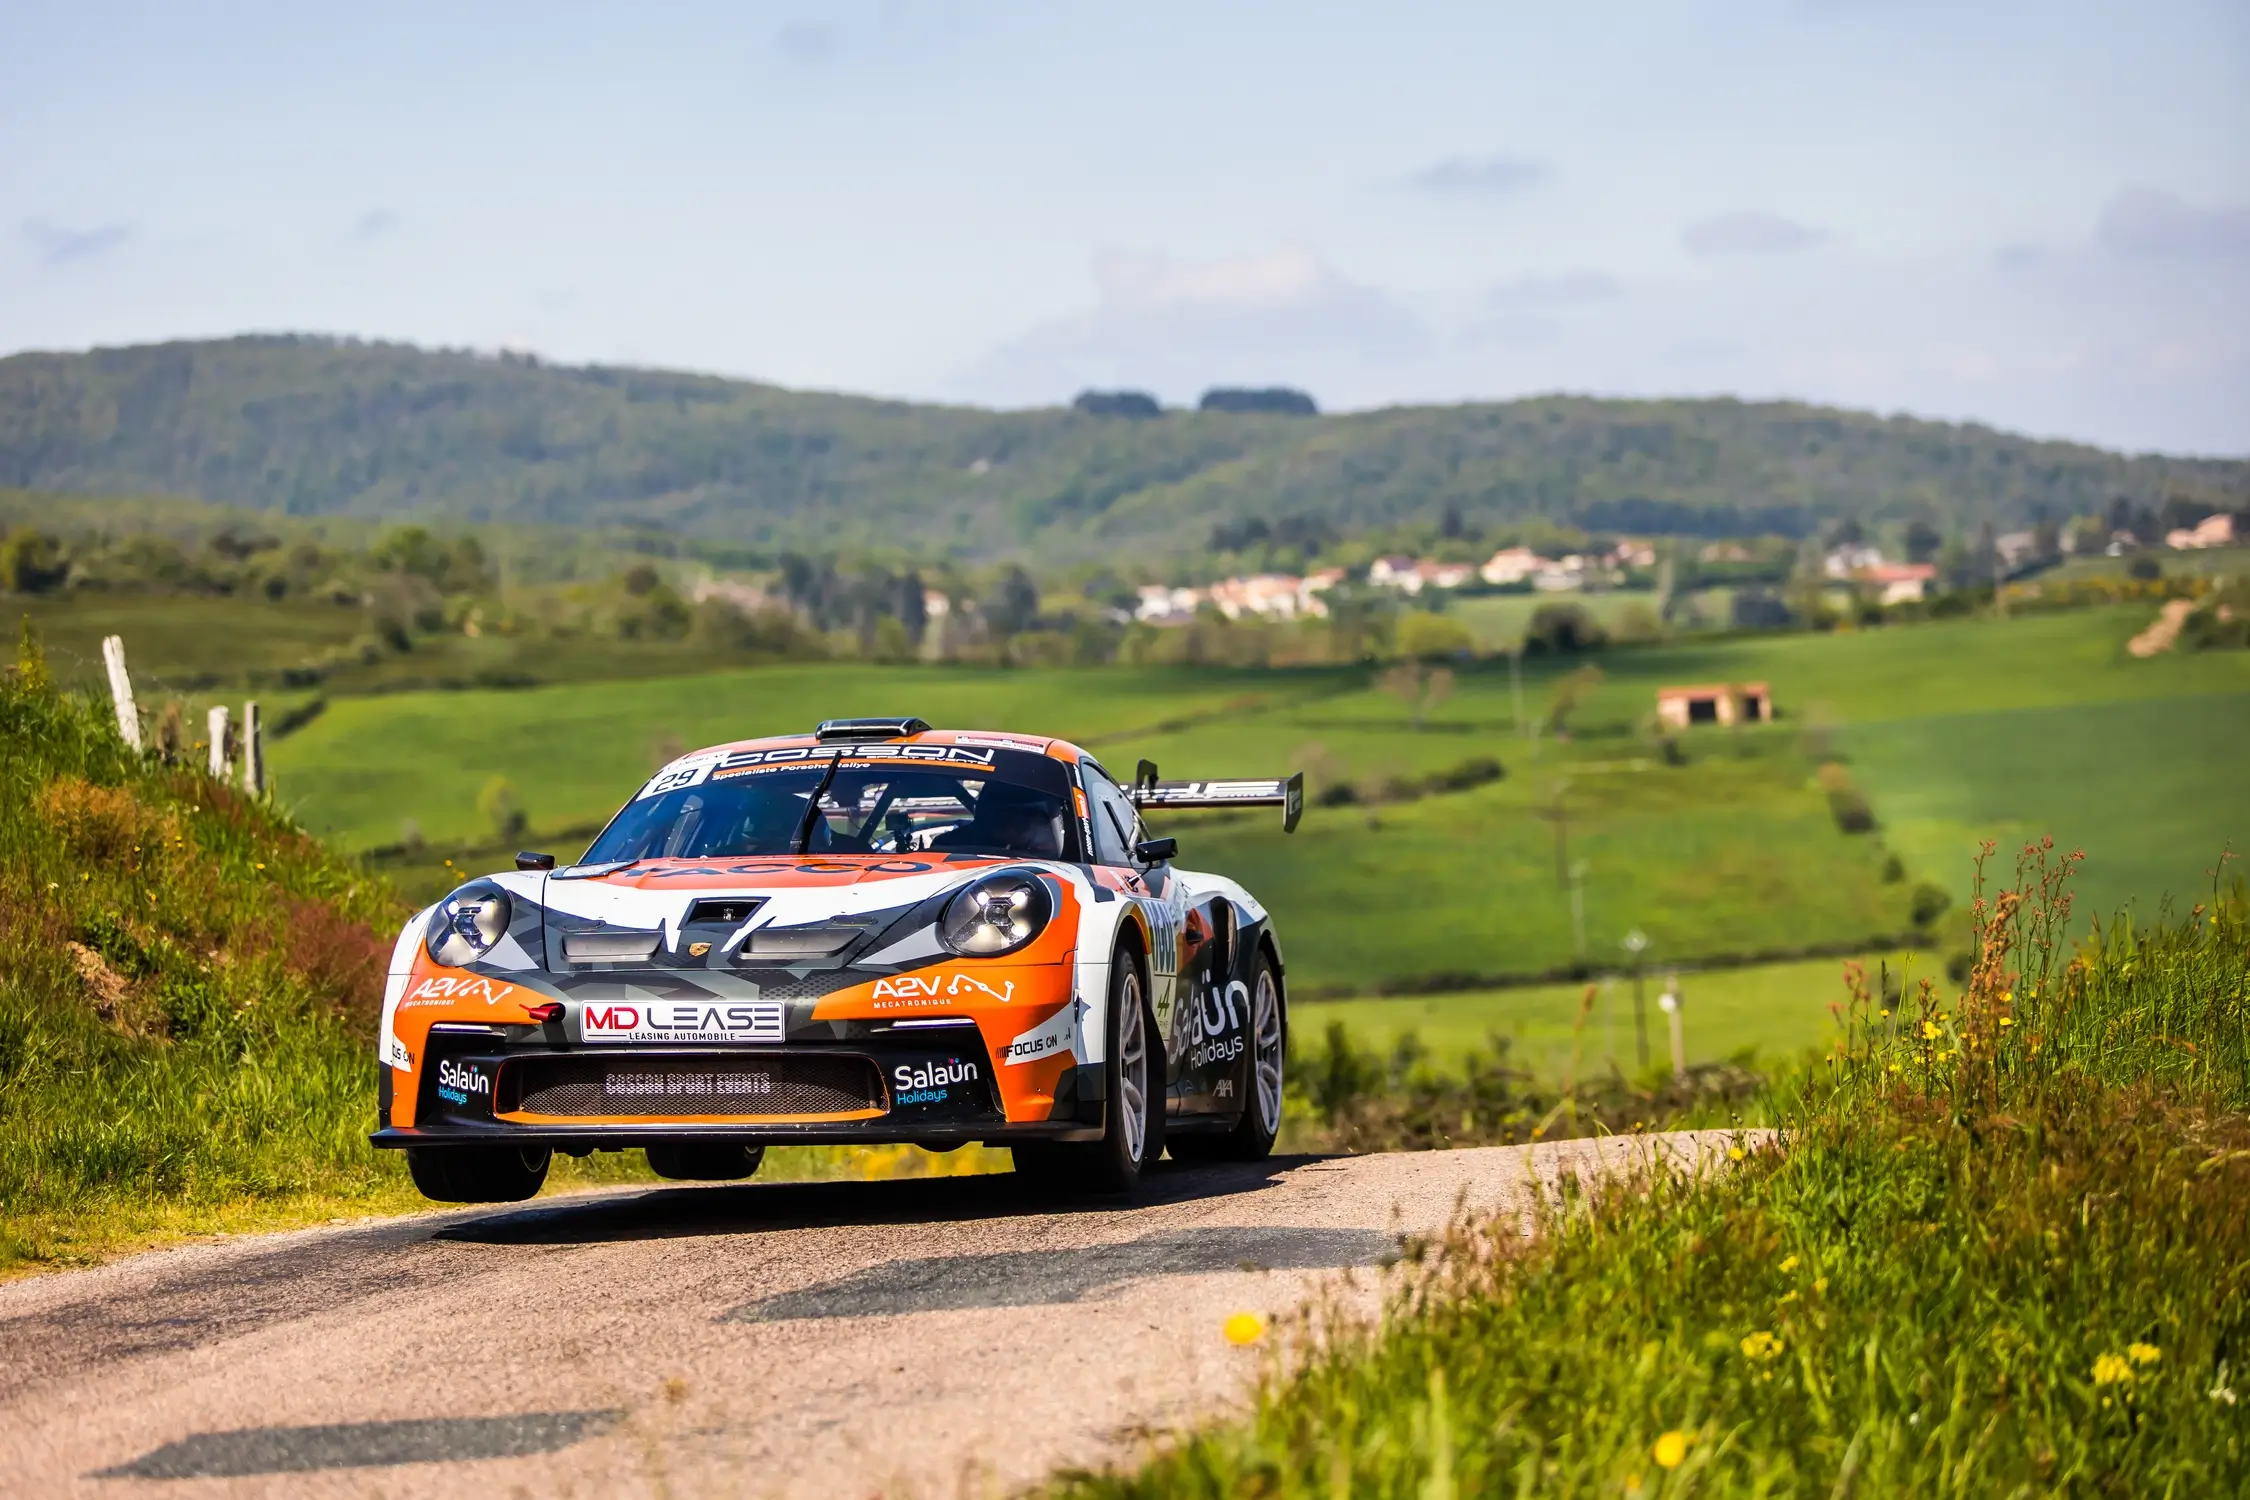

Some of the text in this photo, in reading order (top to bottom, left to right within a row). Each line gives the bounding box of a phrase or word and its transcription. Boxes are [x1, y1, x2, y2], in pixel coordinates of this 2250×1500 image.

[720, 746, 995, 768] COSSON
[781, 763, 830, 772] Porsche
[653, 768, 698, 793] 29
[410, 978, 472, 999] A2V
[872, 975, 941, 999] A2V
[873, 998, 952, 1009] MECATRONIQUE
[586, 1006, 780, 1030] MD LEASE
[629, 1032, 736, 1041] LEASING AUTOMOBILE
[1004, 1039, 1044, 1058] FOCUS
[1046, 1034, 1058, 1049] ON
[1191, 1035, 1244, 1071] Holidays
[439, 1060, 489, 1094] Salaün
[894, 1057, 978, 1091] Salaün
[438, 1085, 468, 1105] Holidays
[896, 1089, 948, 1105] Holidays
